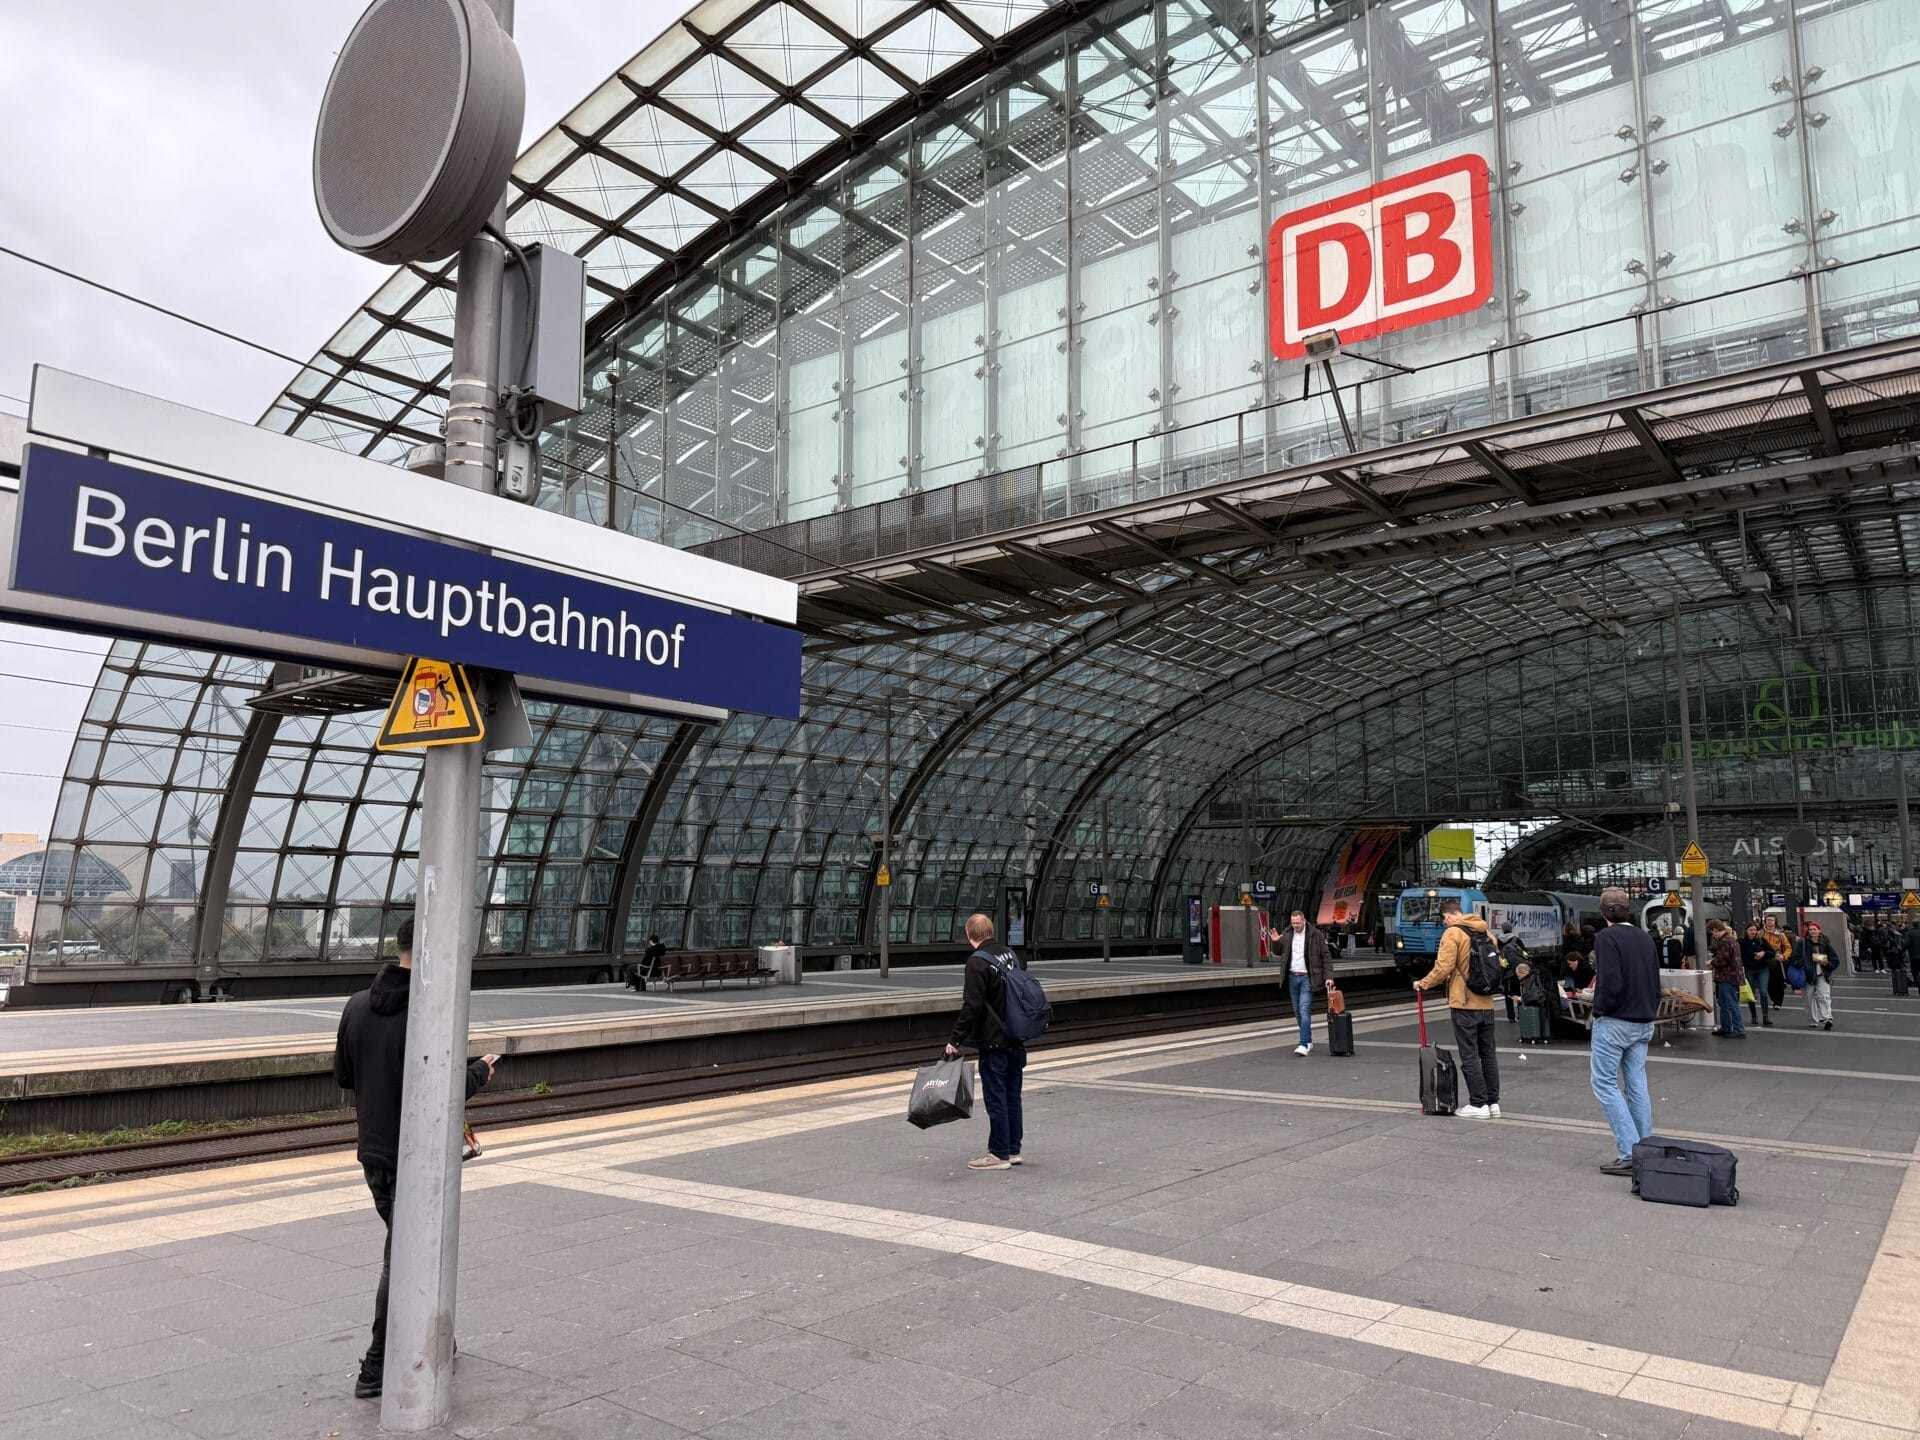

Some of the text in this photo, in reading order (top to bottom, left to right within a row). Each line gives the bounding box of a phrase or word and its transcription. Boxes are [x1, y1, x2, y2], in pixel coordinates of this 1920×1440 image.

[1296, 191, 1463, 332] DB
[71, 484, 686, 670] Berlin Hauptbahnhof
[1732, 836, 1856, 857] ALSOM
[1399, 880, 1408, 889] 11
[1648, 877, 1661, 891] G
[1853, 875, 1866, 884] 14
[1090, 883, 1099, 894] G
[1255, 880, 1266, 893] G
